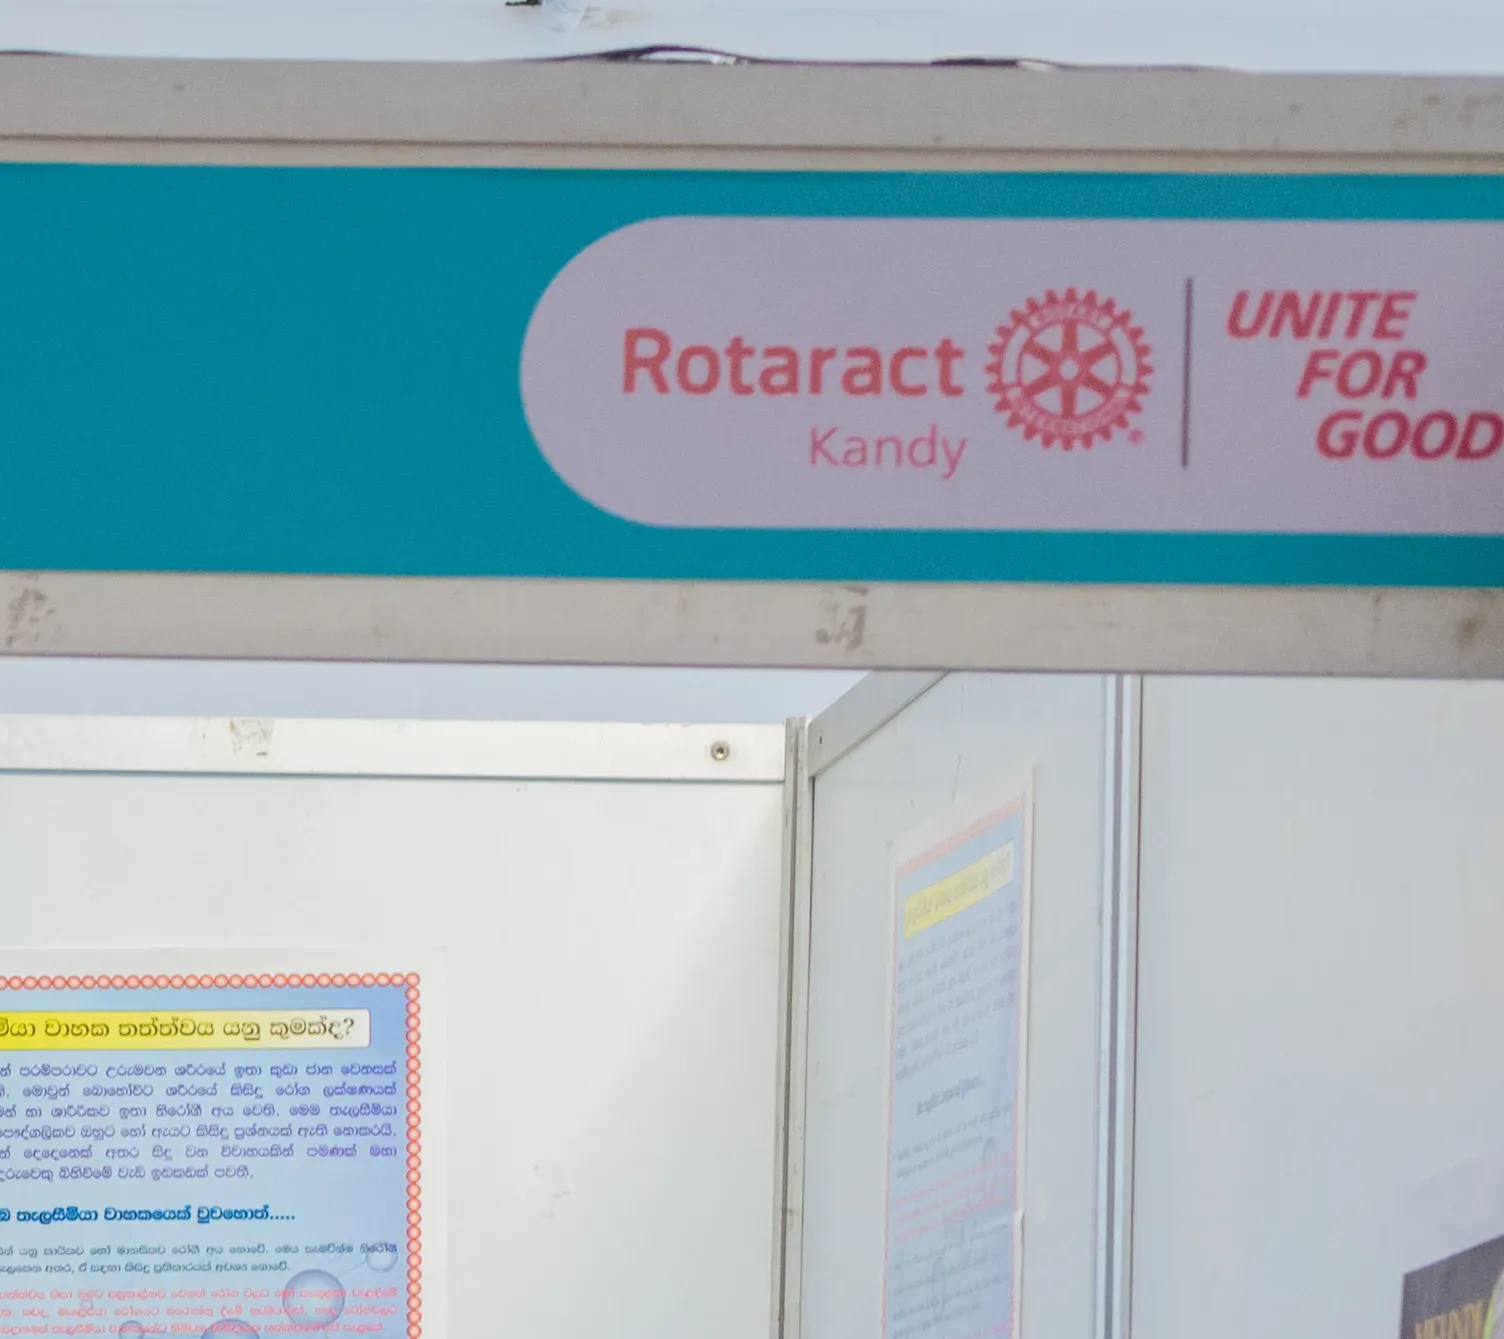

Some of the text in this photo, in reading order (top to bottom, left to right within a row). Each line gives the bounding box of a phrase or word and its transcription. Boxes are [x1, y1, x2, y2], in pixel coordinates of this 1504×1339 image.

[1226, 289, 1418, 340] UNITE
[621, 327, 966, 398] Rotaract
[1296, 348, 1429, 400] FOR
[808, 424, 968, 479] Kandy
[1315, 408, 1504, 461] GOOD
[44, 1020, 110, 1038] වාහක
[118, 1015, 215, 1038] තත්ත්වය
[222, 1021, 261, 1042] යනු
[269, 1014, 355, 1041] කුමක්ද?
[15, 1205, 99, 1225] තැලසීමියා
[103, 1204, 192, 1221] වාහකයෙක්
